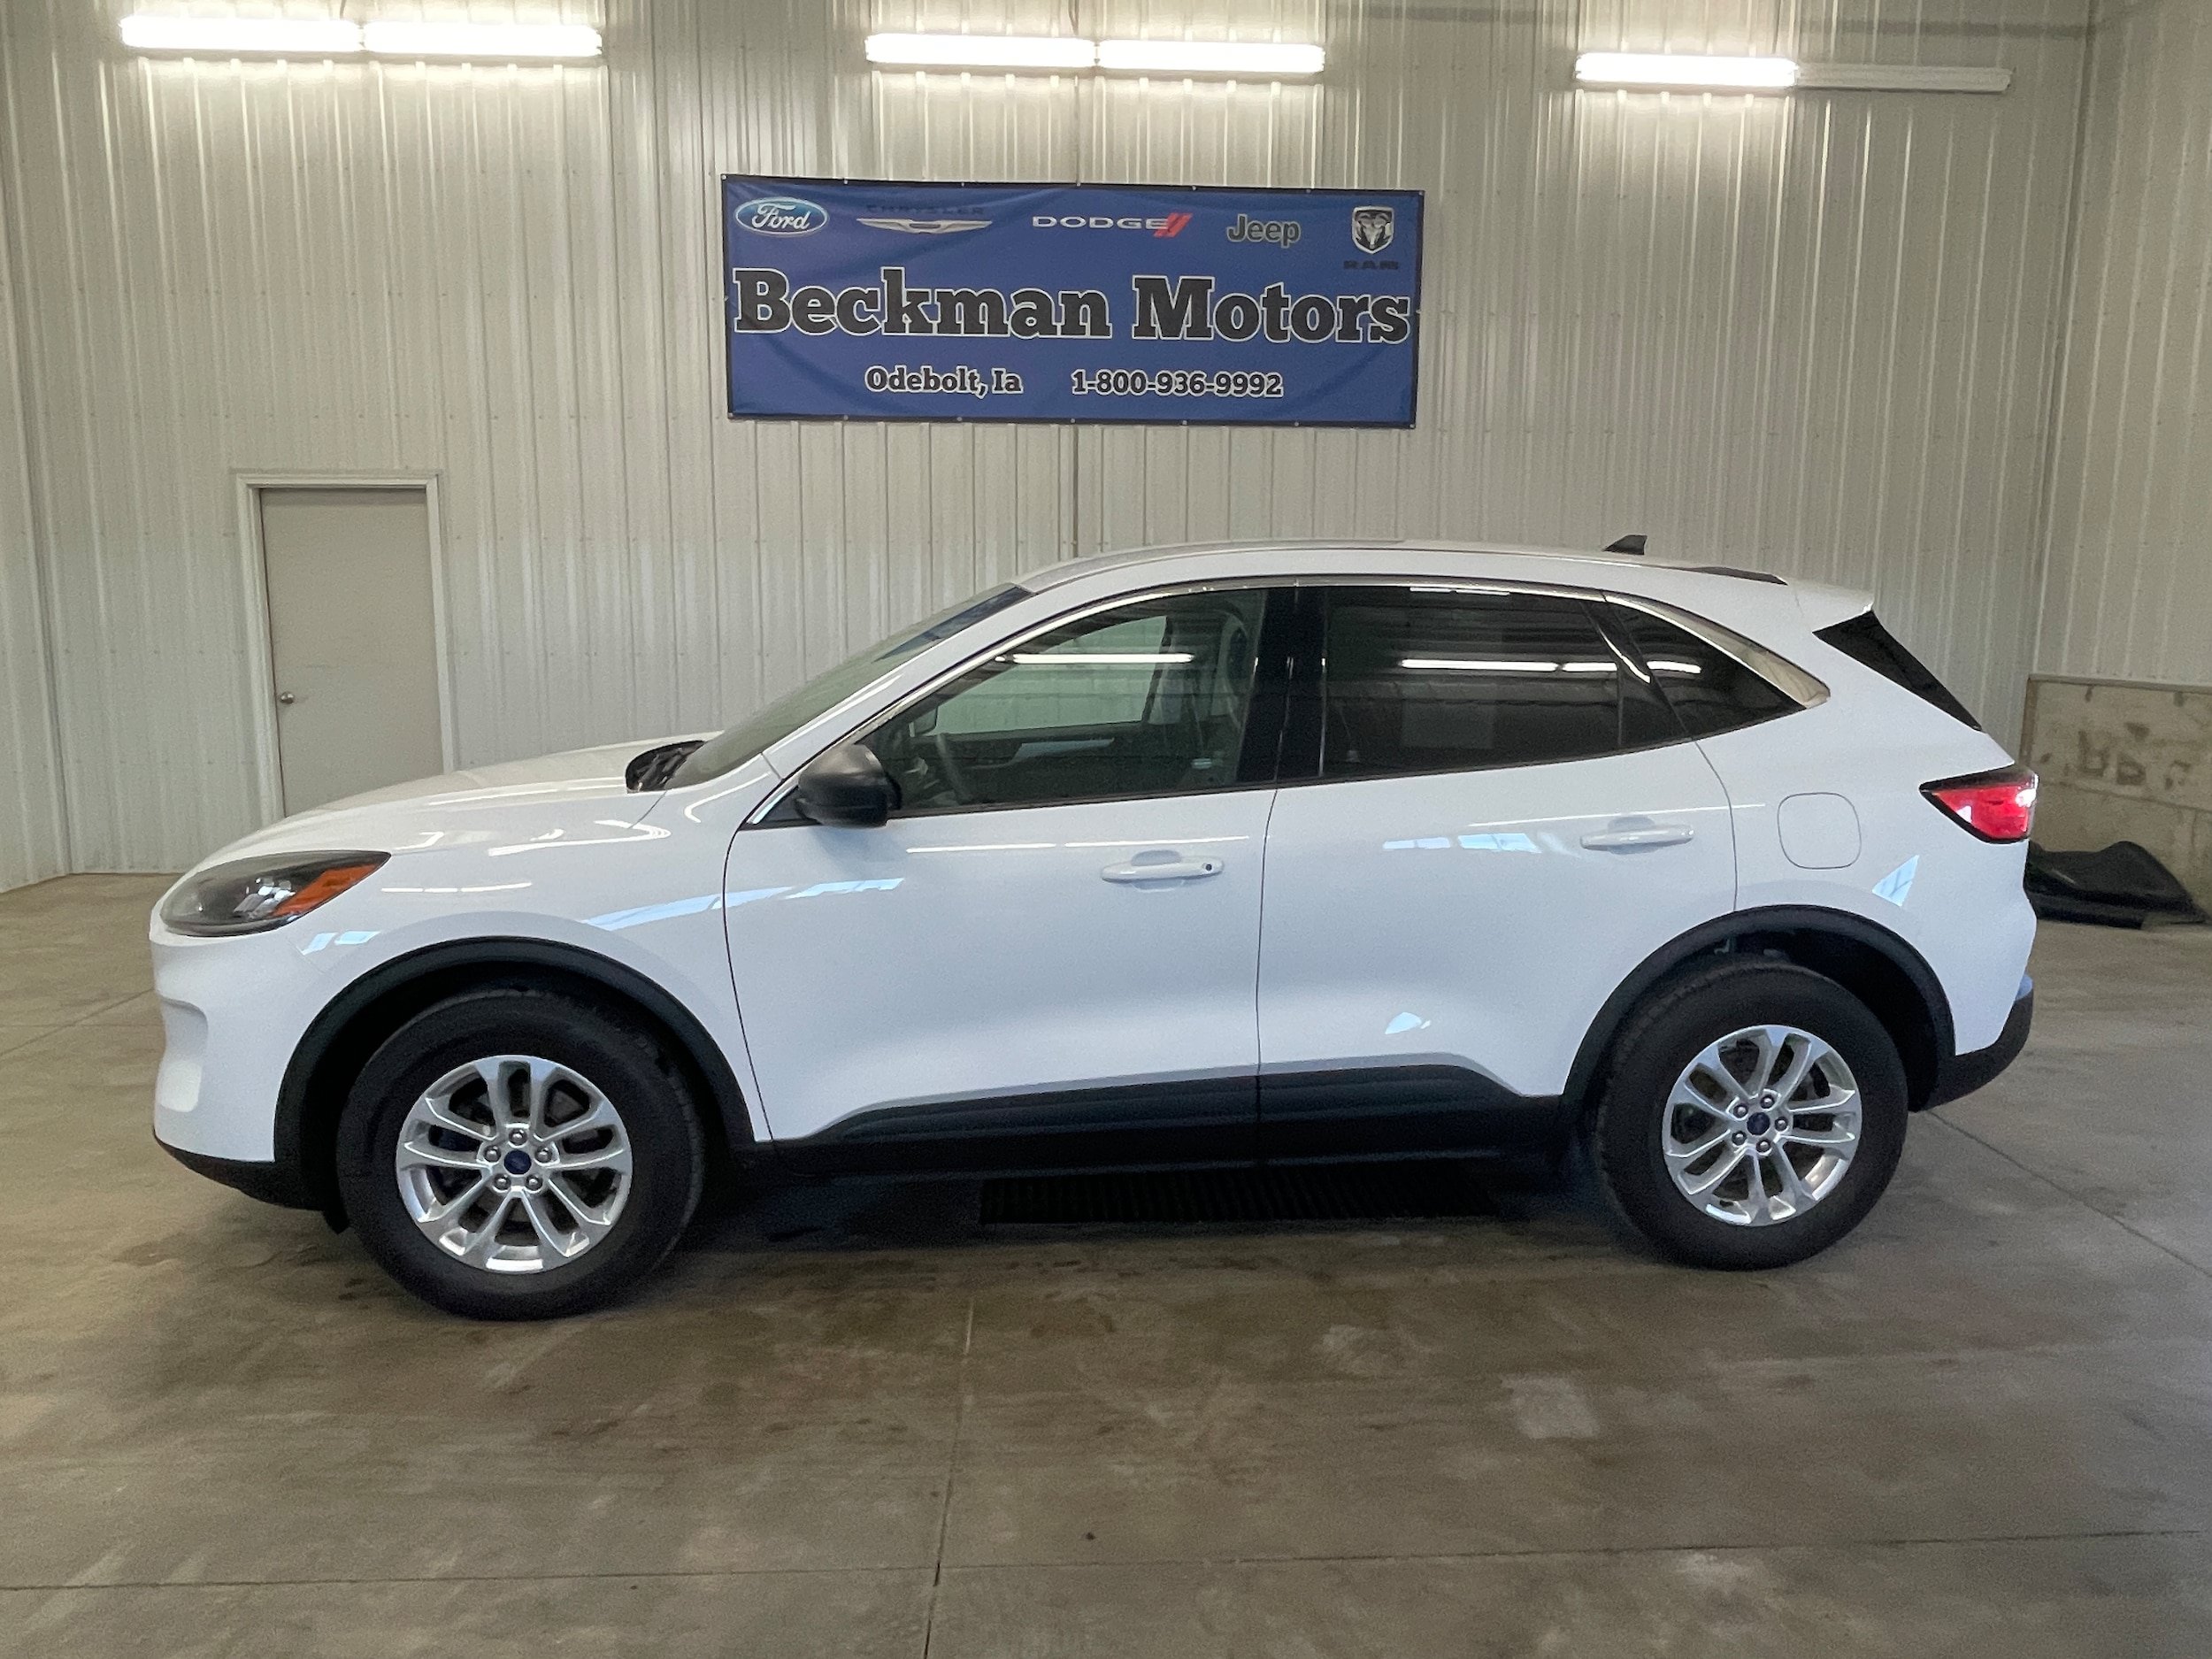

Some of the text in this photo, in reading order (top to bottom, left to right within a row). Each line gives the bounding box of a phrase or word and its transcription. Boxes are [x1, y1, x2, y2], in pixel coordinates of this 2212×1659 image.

[751, 203, 811, 230] Ford
[1032, 215, 1169, 230] DODGE
[1226, 213, 1302, 249] Jeep
[733, 266, 1410, 344] Beckman Motors
[864, 365, 1023, 398] Odebolt, Ia
[1071, 368, 1284, 398] 1-800-936-9992
